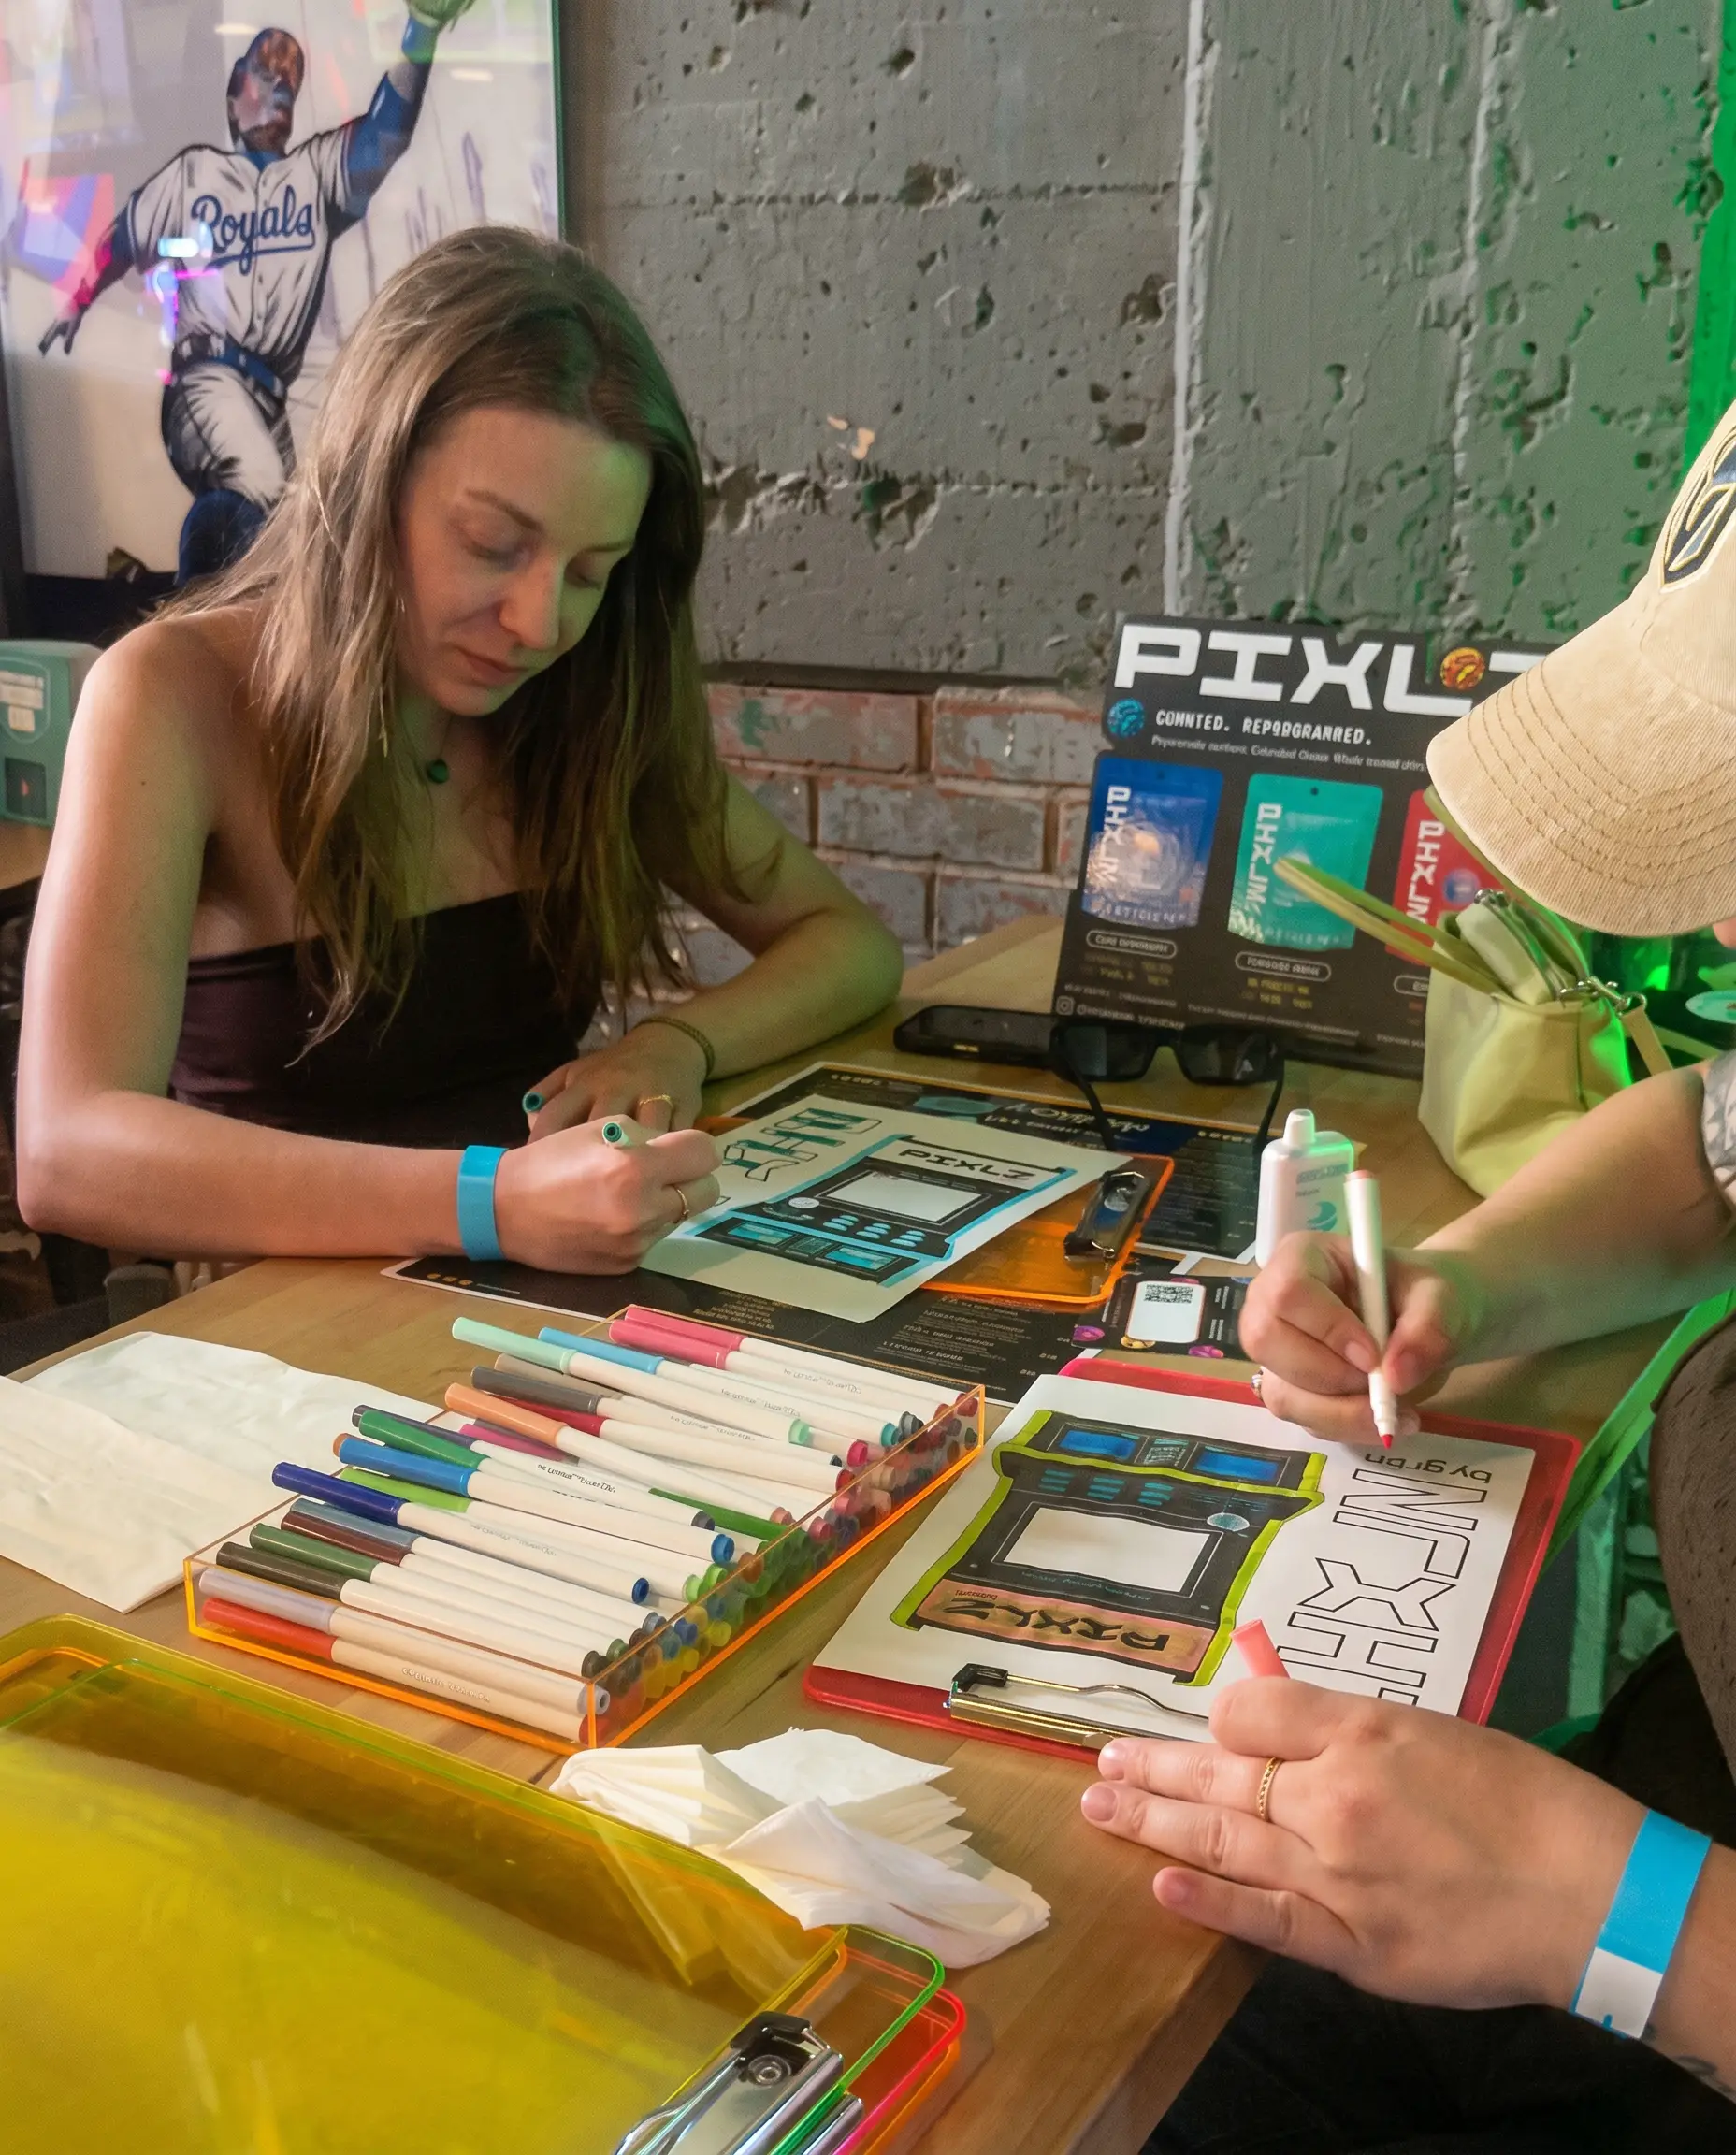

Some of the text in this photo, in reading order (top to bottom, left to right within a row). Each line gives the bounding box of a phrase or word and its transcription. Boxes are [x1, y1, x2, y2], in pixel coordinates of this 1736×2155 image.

[191, 185, 315, 275] Royals
[899, 1149, 1036, 1180] PIXLZ
[1449, 1464, 1493, 1484] by
